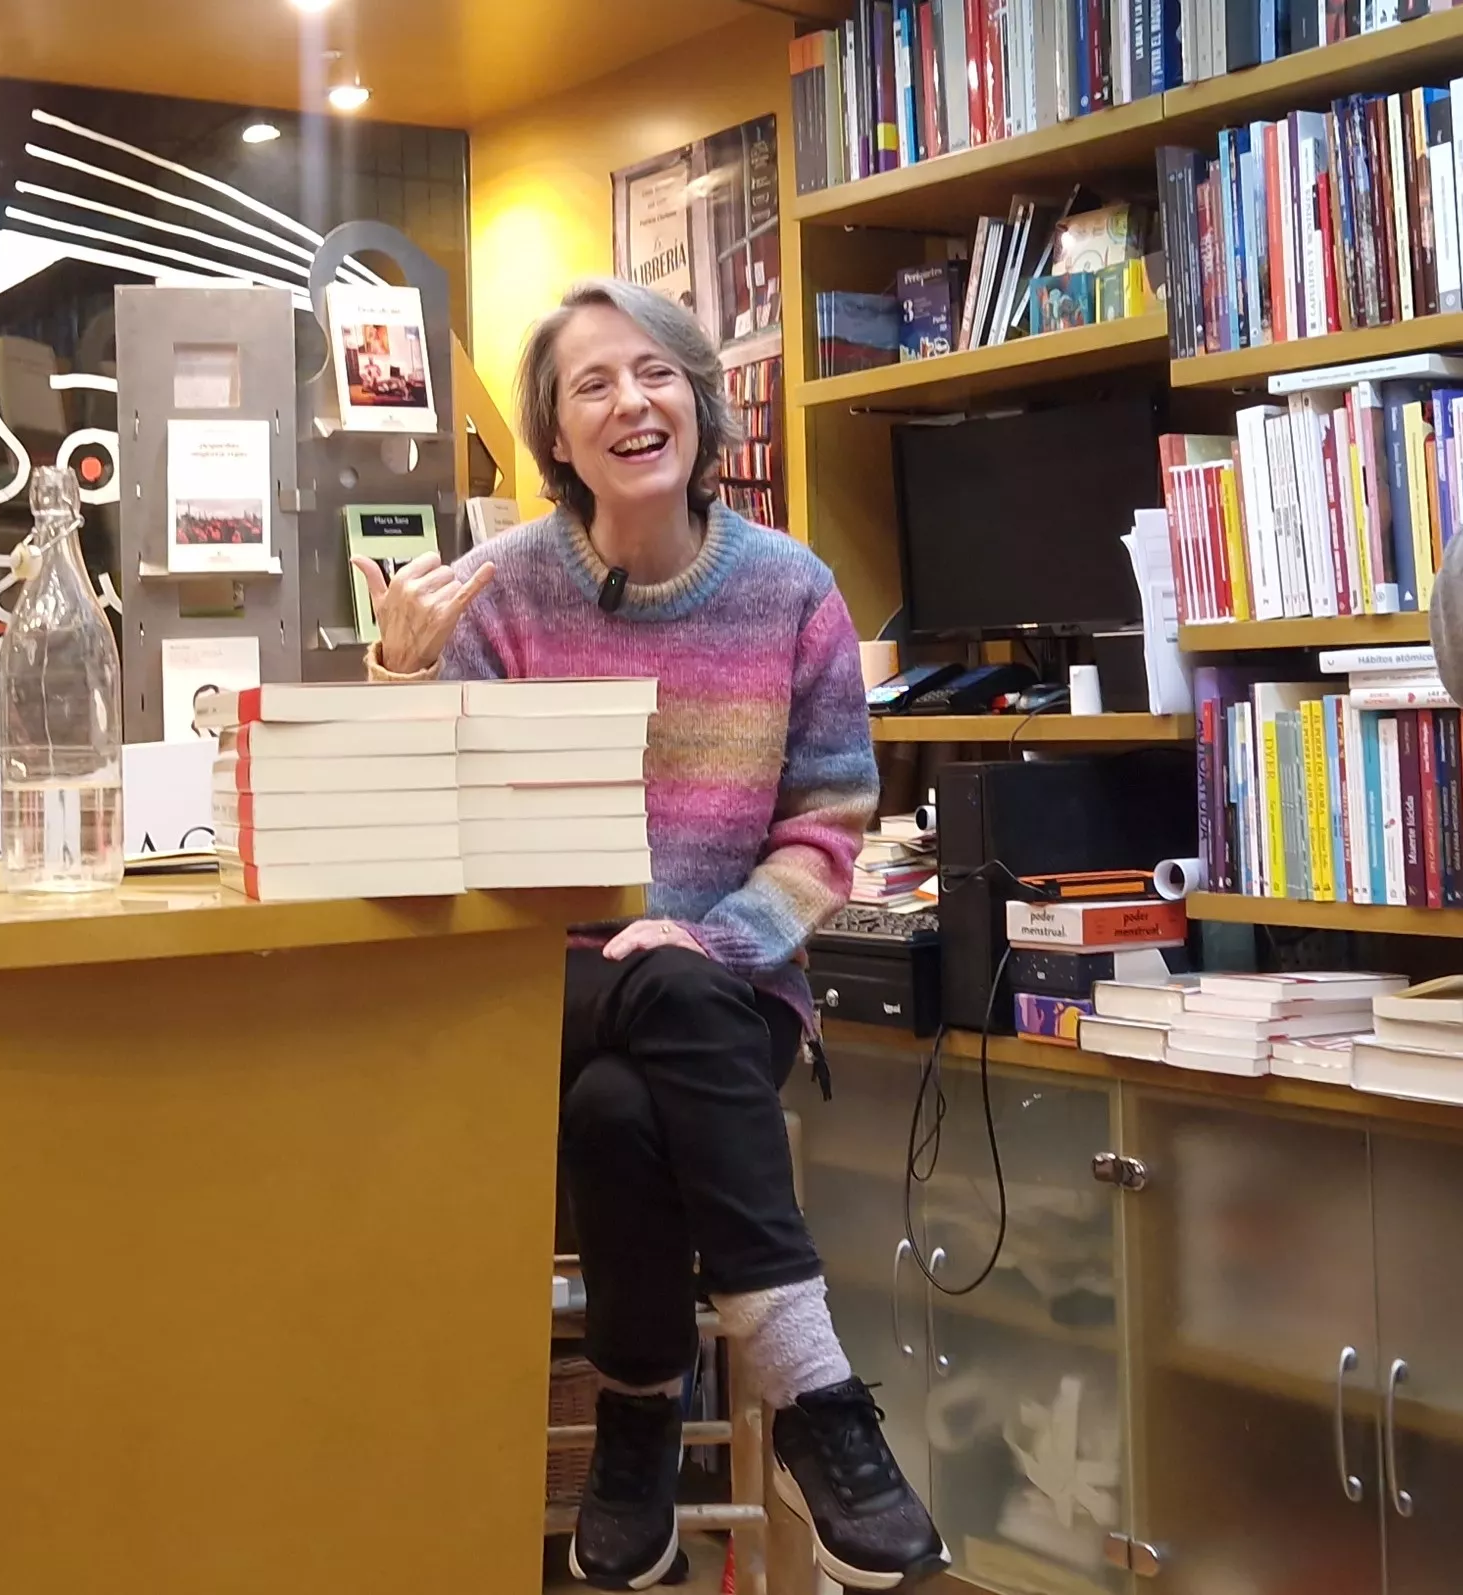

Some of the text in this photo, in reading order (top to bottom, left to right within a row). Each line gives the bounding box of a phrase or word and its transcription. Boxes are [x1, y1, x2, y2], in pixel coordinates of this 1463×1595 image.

[633, 238, 687, 287] LIBRERÍA
[903, 299, 915, 323] 3
[1358, 652, 1434, 665] Hábitos atómico
[1264, 737, 1276, 780] DYER
[1405, 795, 1418, 865] Muerte lúcida
[1030, 909, 1055, 925] poder
[1122, 908, 1149, 926] poder
